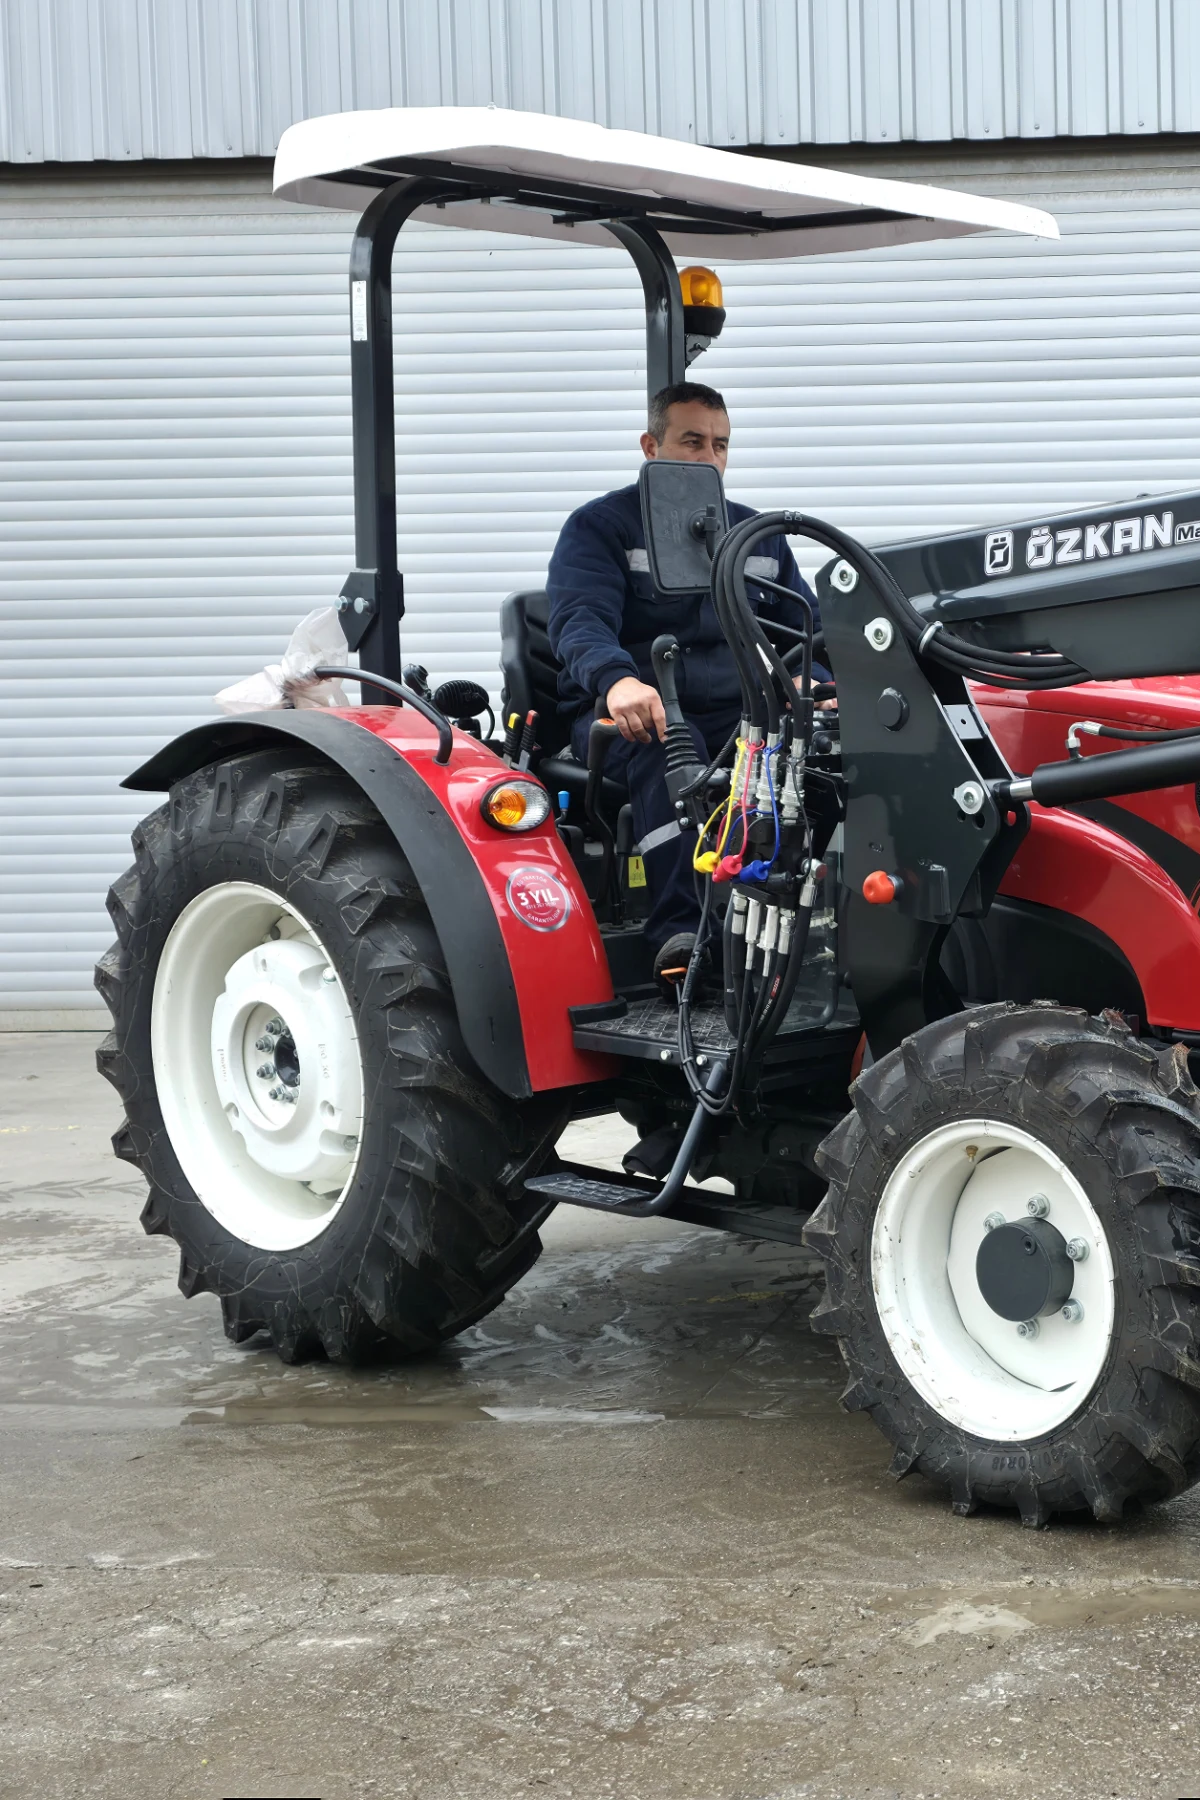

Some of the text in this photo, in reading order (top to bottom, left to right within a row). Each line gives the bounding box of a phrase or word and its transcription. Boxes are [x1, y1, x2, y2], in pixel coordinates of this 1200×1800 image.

[1026, 512, 1172, 568] ÖZKAN
[517, 892, 529, 906] 3
[528, 888, 559, 904] YIL
